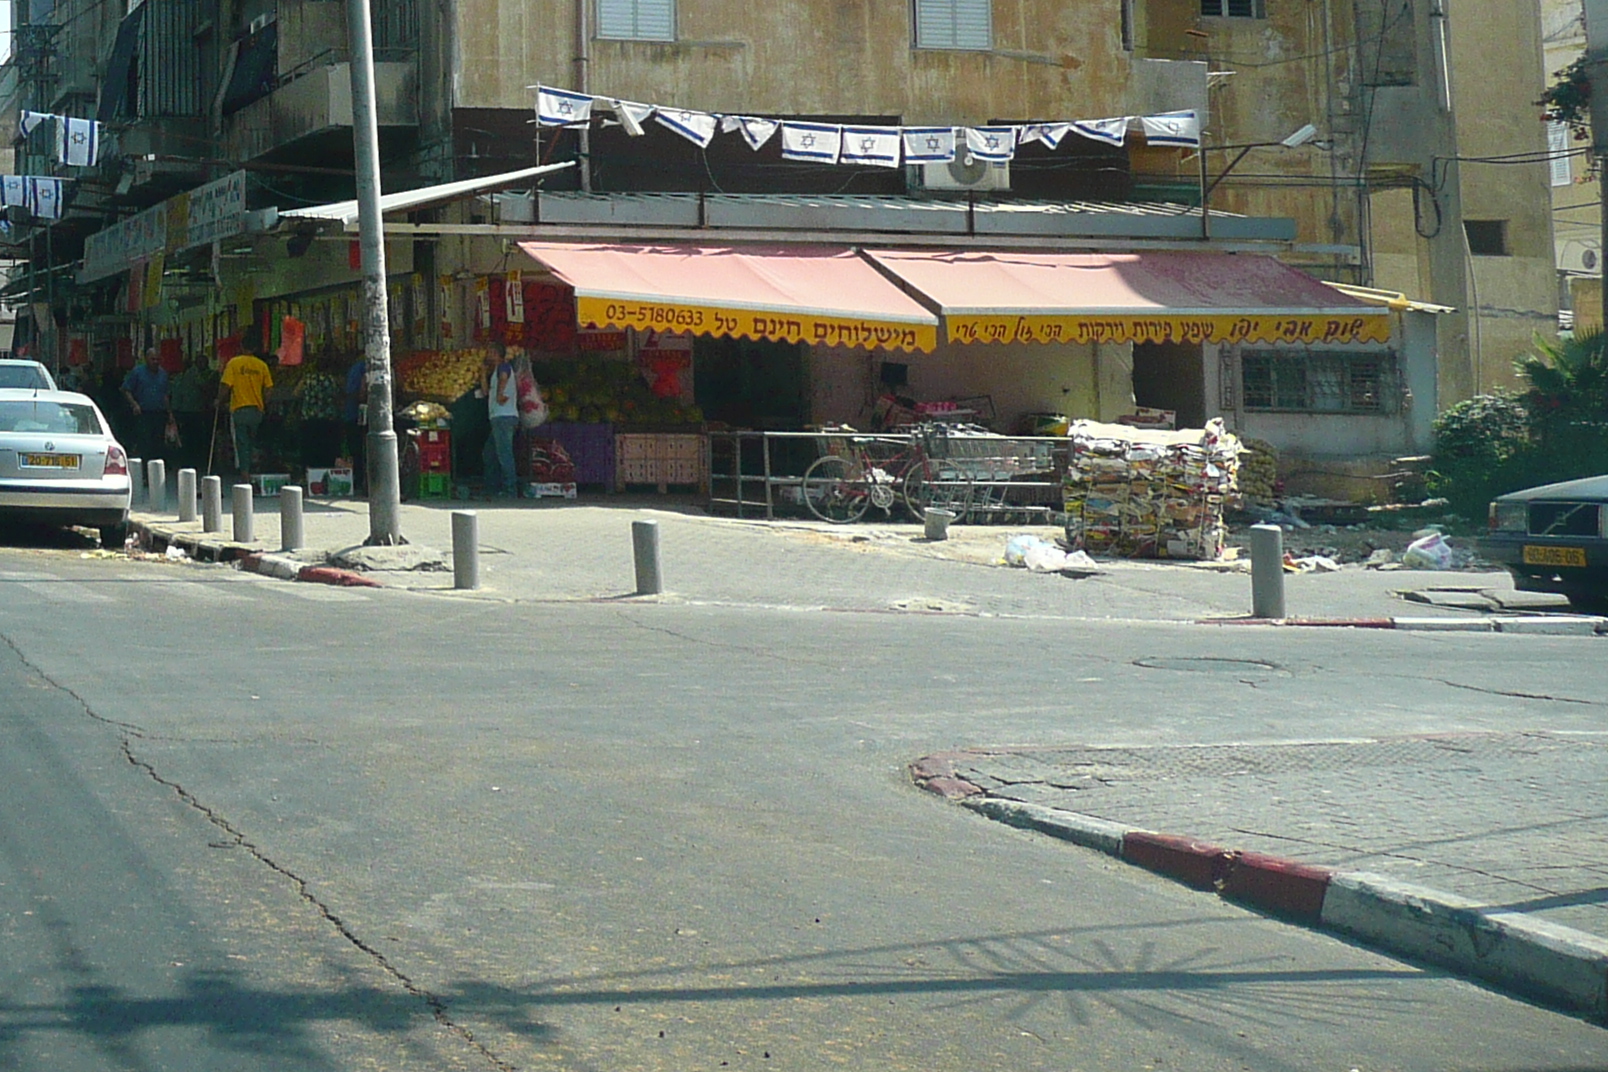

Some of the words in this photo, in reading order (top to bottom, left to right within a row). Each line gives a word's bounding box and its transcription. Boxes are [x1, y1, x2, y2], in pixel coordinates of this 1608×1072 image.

[606, 304, 703, 326] 03-5180633
[714, 312, 738, 331] טל
[753, 317, 801, 337] חינם
[813, 322, 916, 346] מישלוחים
[956, 321, 978, 338] טרי
[984, 324, 1007, 338] הכי
[1014, 316, 1033, 341] זול
[1040, 324, 1063, 338] הכי
[1078, 320, 1126, 342] וירקות
[1132, 320, 1173, 338] פירות
[1180, 320, 1214, 338] שפע
[1275, 320, 1313, 337] אבי
[1323, 318, 1364, 342] שוק
